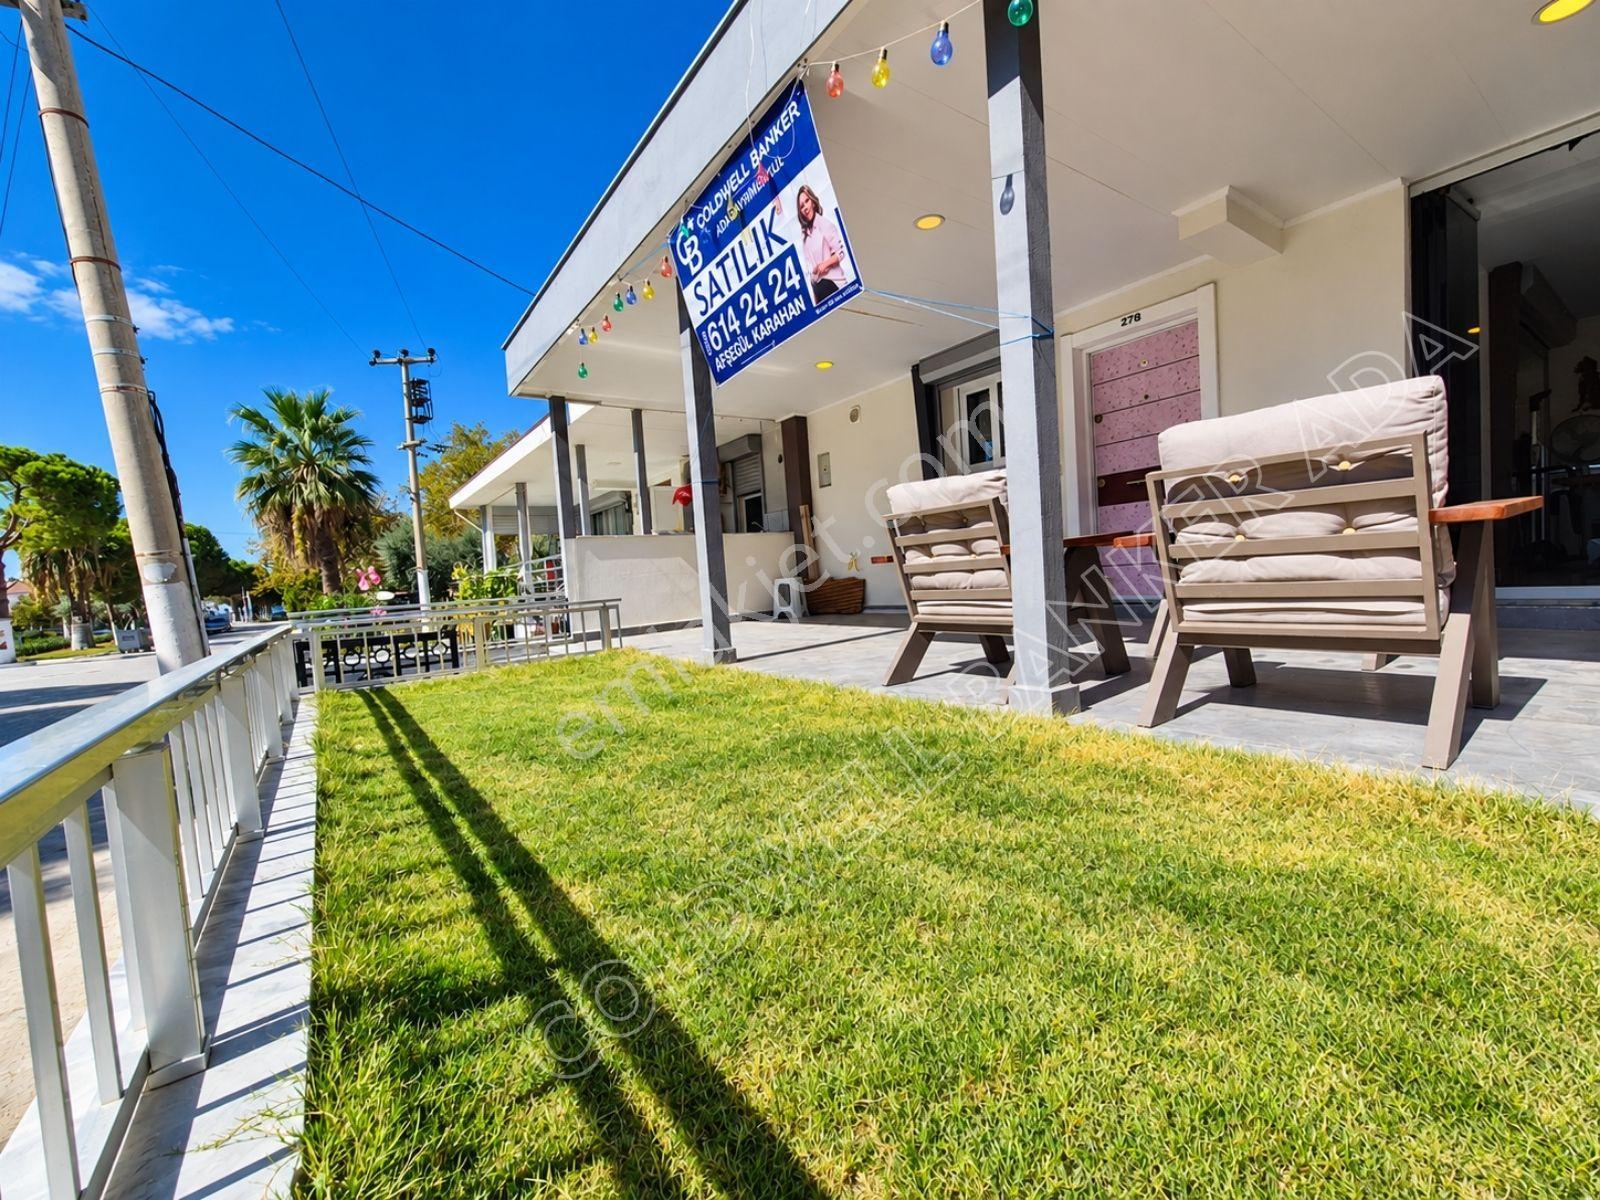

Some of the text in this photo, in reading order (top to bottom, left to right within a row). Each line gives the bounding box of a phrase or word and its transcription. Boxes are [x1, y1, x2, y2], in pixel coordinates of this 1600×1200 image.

[696, 101, 801, 229] COLDWELL BANKER
[693, 205, 788, 317] SATILIK
[707, 305, 741, 351] 614
[739, 282, 769, 328] 24
[768, 255, 801, 306] 24
[751, 294, 806, 344] KARAHAN
